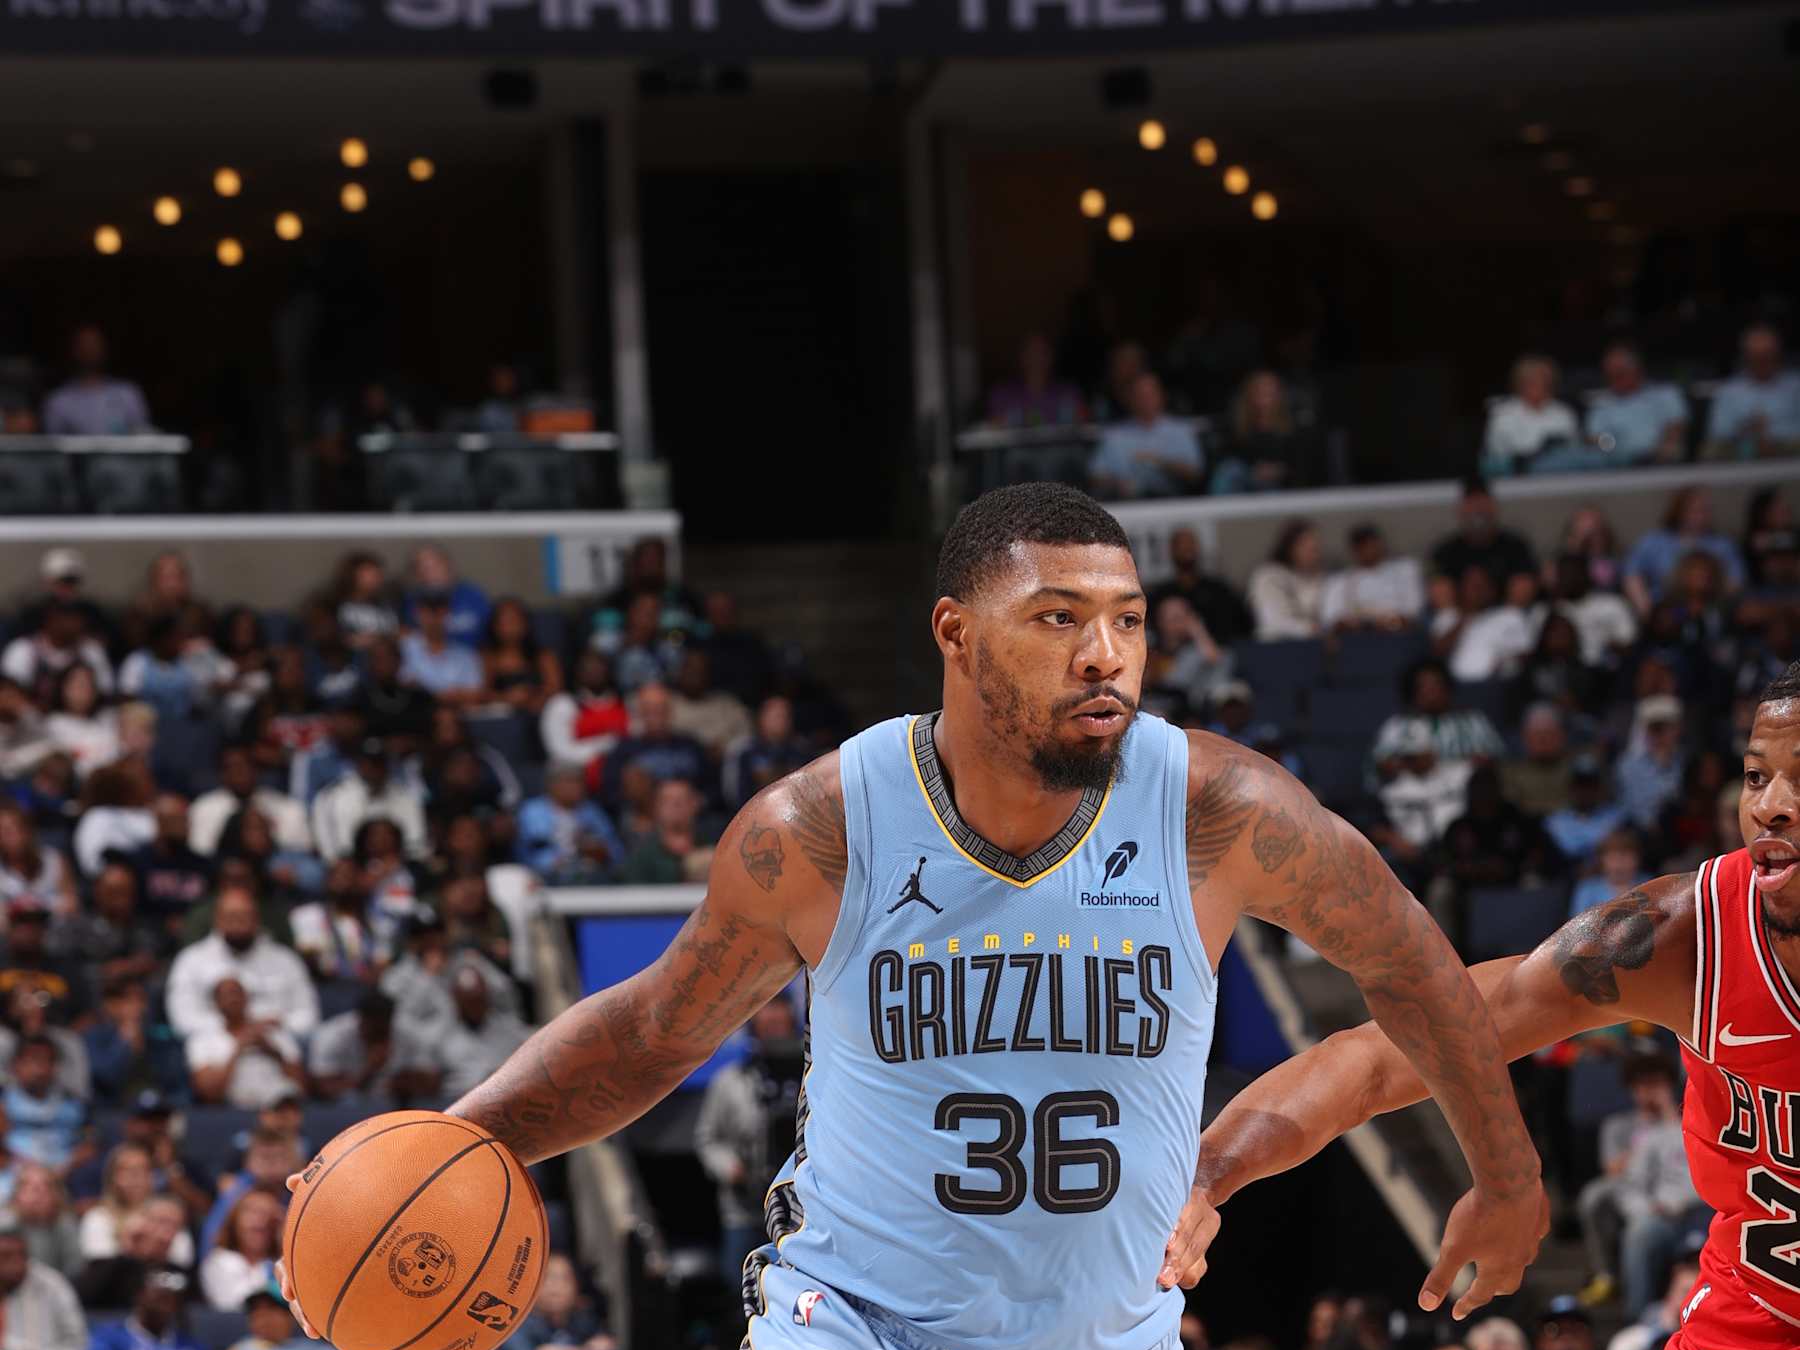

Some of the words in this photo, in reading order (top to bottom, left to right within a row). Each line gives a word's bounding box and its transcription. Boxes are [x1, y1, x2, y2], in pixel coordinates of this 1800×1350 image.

[1080, 891, 1160, 907] Robinhood
[908, 932, 1134, 959] MEMPHIS
[868, 944, 1173, 1064] GRIZZLIES
[933, 1089, 1122, 1216] 36
